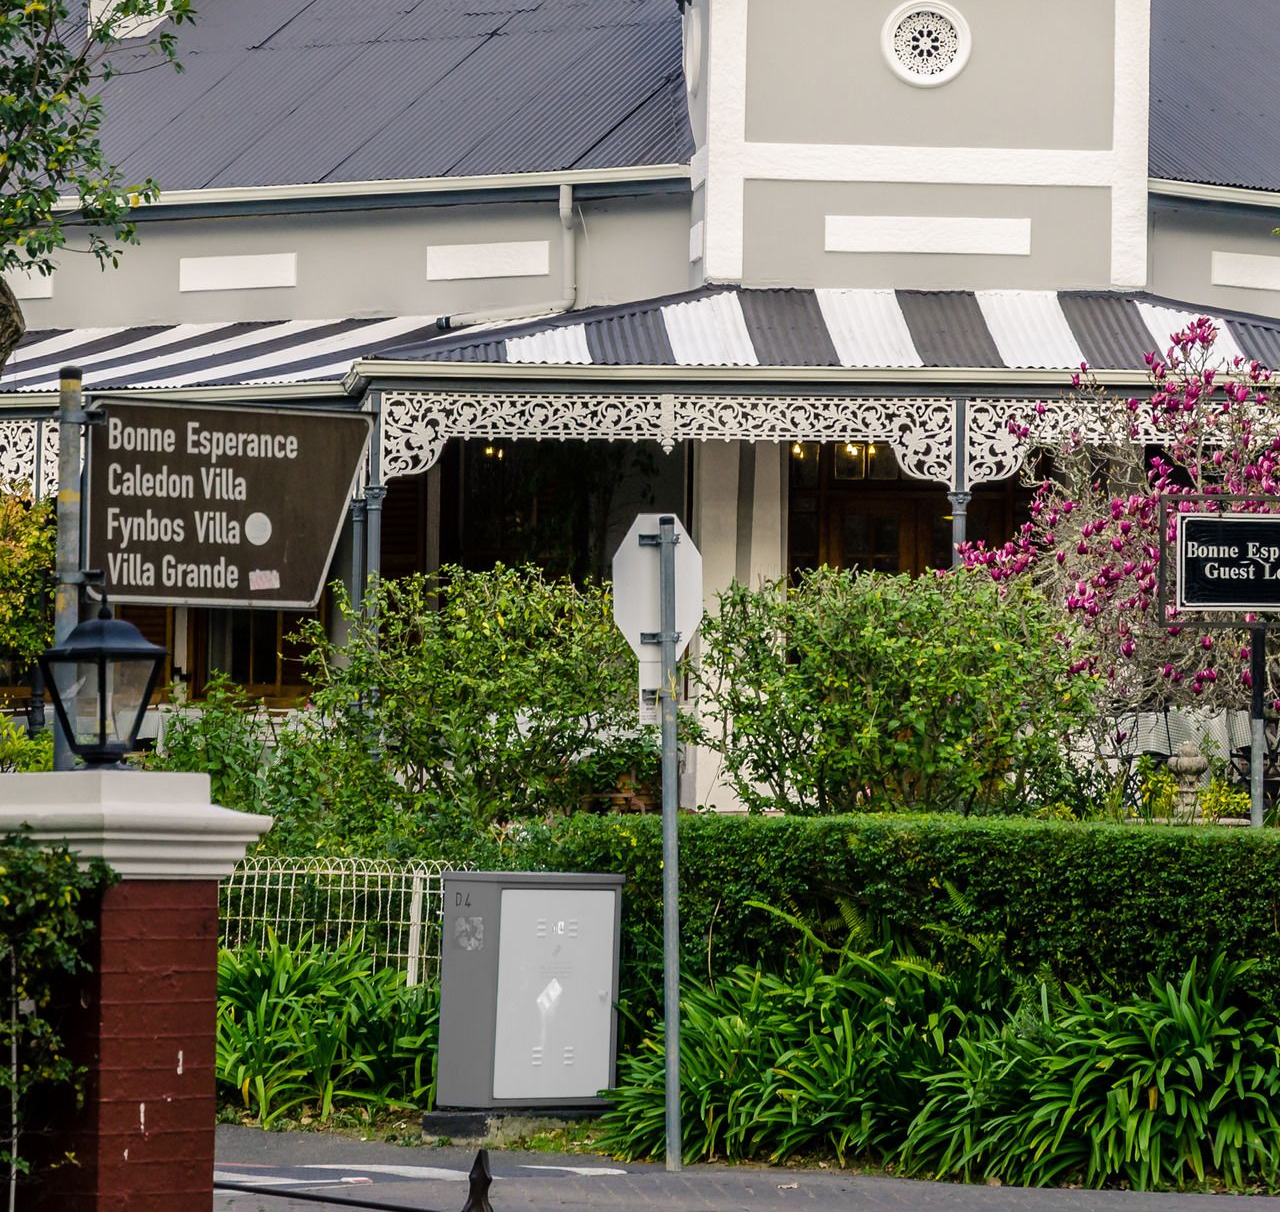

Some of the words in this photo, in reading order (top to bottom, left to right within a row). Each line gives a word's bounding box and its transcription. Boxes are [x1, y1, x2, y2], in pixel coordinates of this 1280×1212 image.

[108, 417, 176, 453] Bonne
[187, 421, 298, 463] Esperance
[108, 463, 194, 499] Caledon
[201, 467, 247, 501] Villa
[107, 508, 185, 549] Fynbos
[194, 511, 241, 545] Villa
[1187, 541, 1239, 558] Bonne
[107, 552, 155, 586] Villa
[162, 554, 239, 589] Grande
[1204, 563, 1256, 580] Guest
